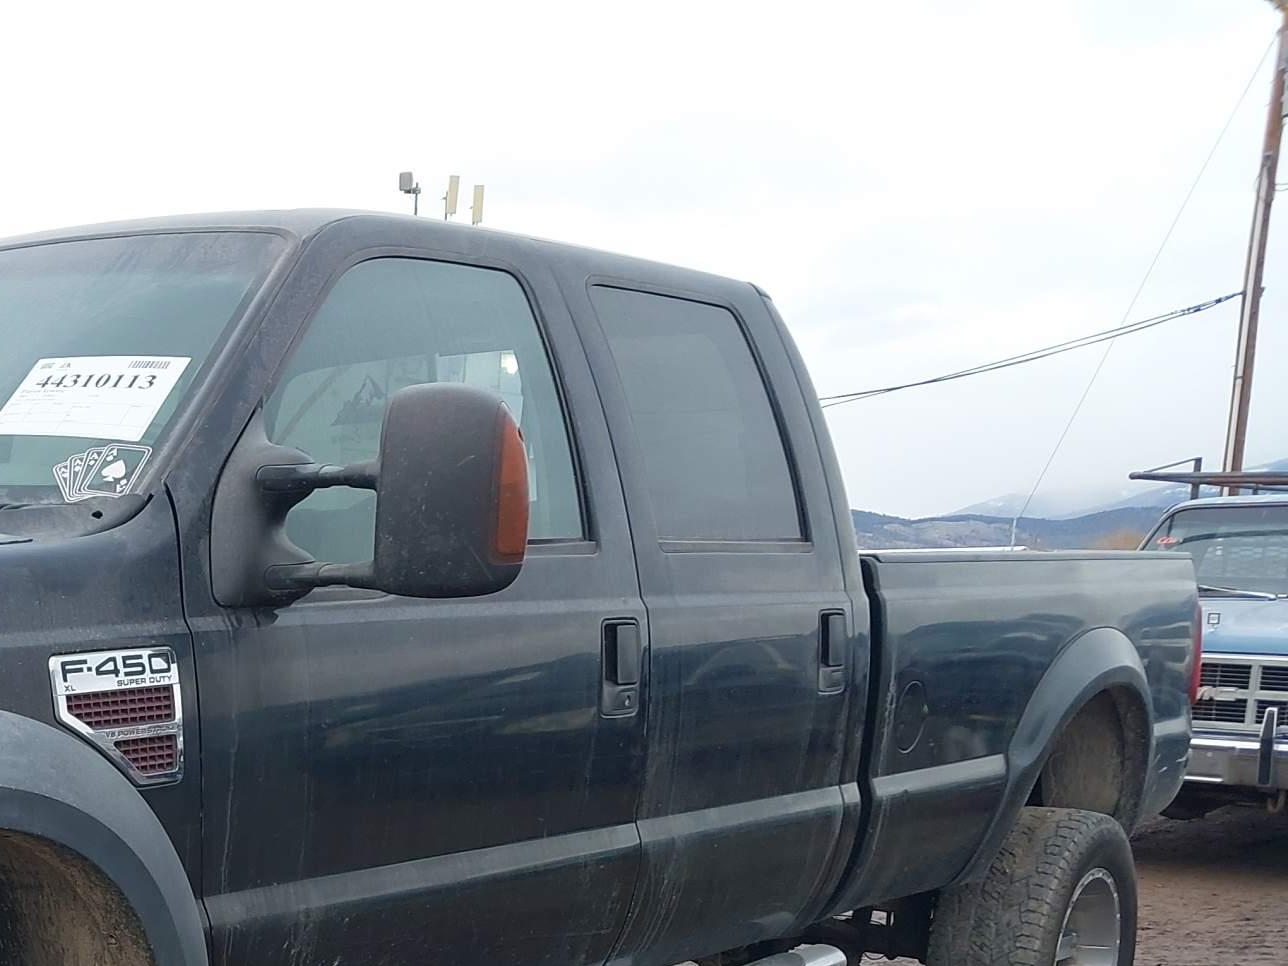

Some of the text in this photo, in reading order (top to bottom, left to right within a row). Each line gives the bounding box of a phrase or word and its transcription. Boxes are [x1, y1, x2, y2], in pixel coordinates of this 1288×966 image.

[35, 373, 158, 390] 44310113
[117, 675, 172, 687] SUPER DUTY
